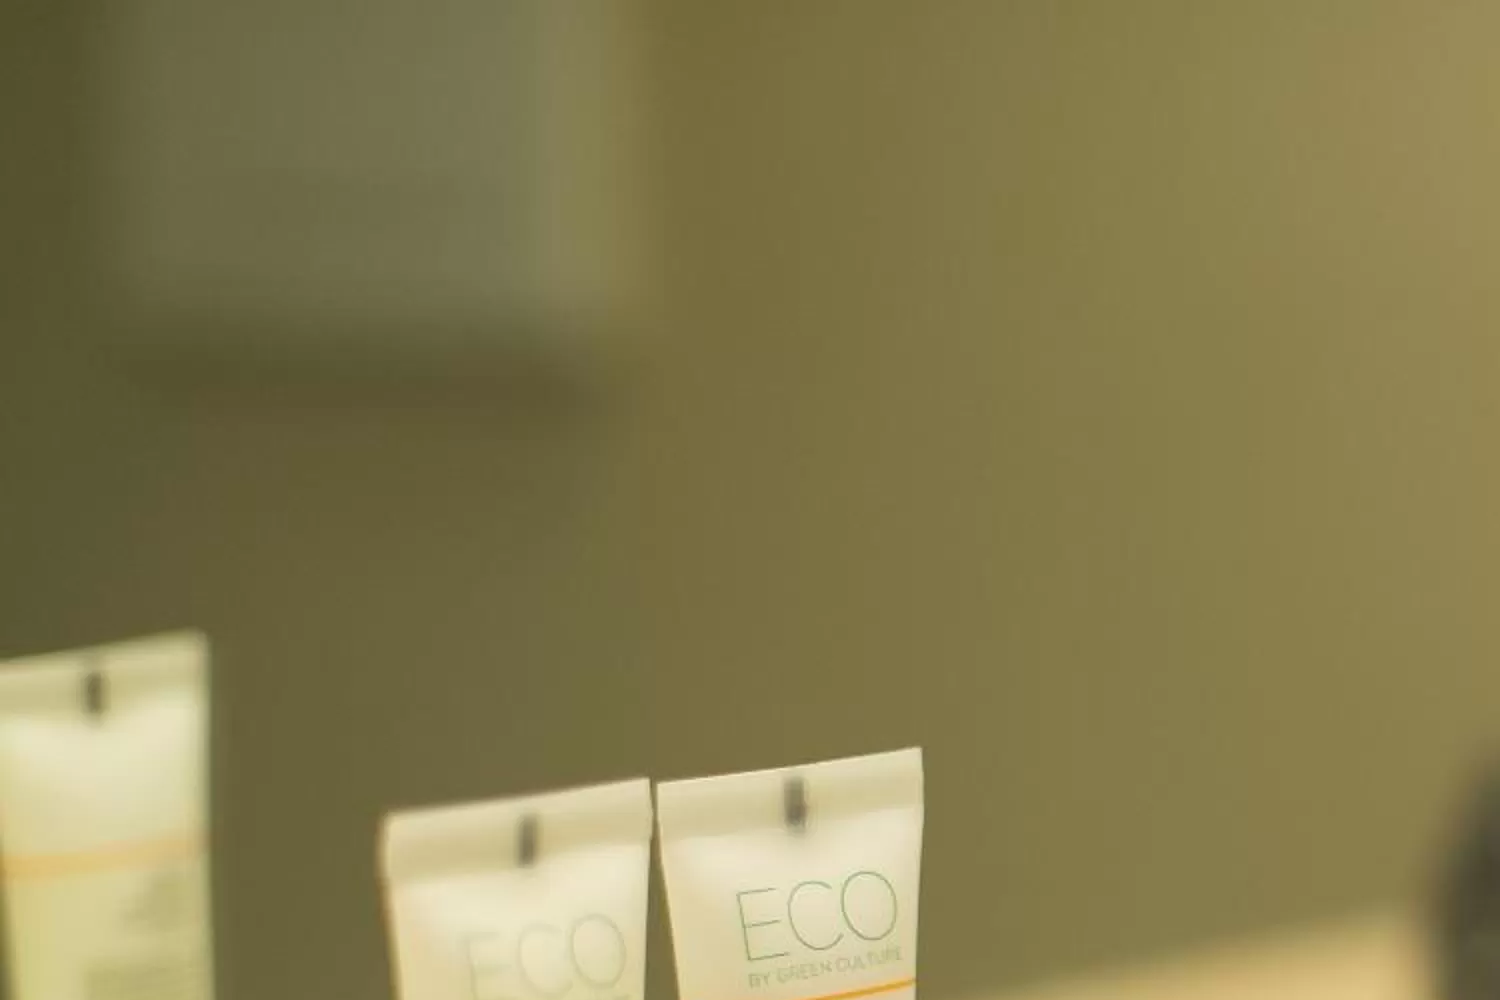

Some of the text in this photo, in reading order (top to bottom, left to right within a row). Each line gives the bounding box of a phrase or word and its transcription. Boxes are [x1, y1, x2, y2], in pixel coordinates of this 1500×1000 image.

[736, 869, 898, 963] ECO
[748, 946, 903, 989] BY GREEN CULTURE
